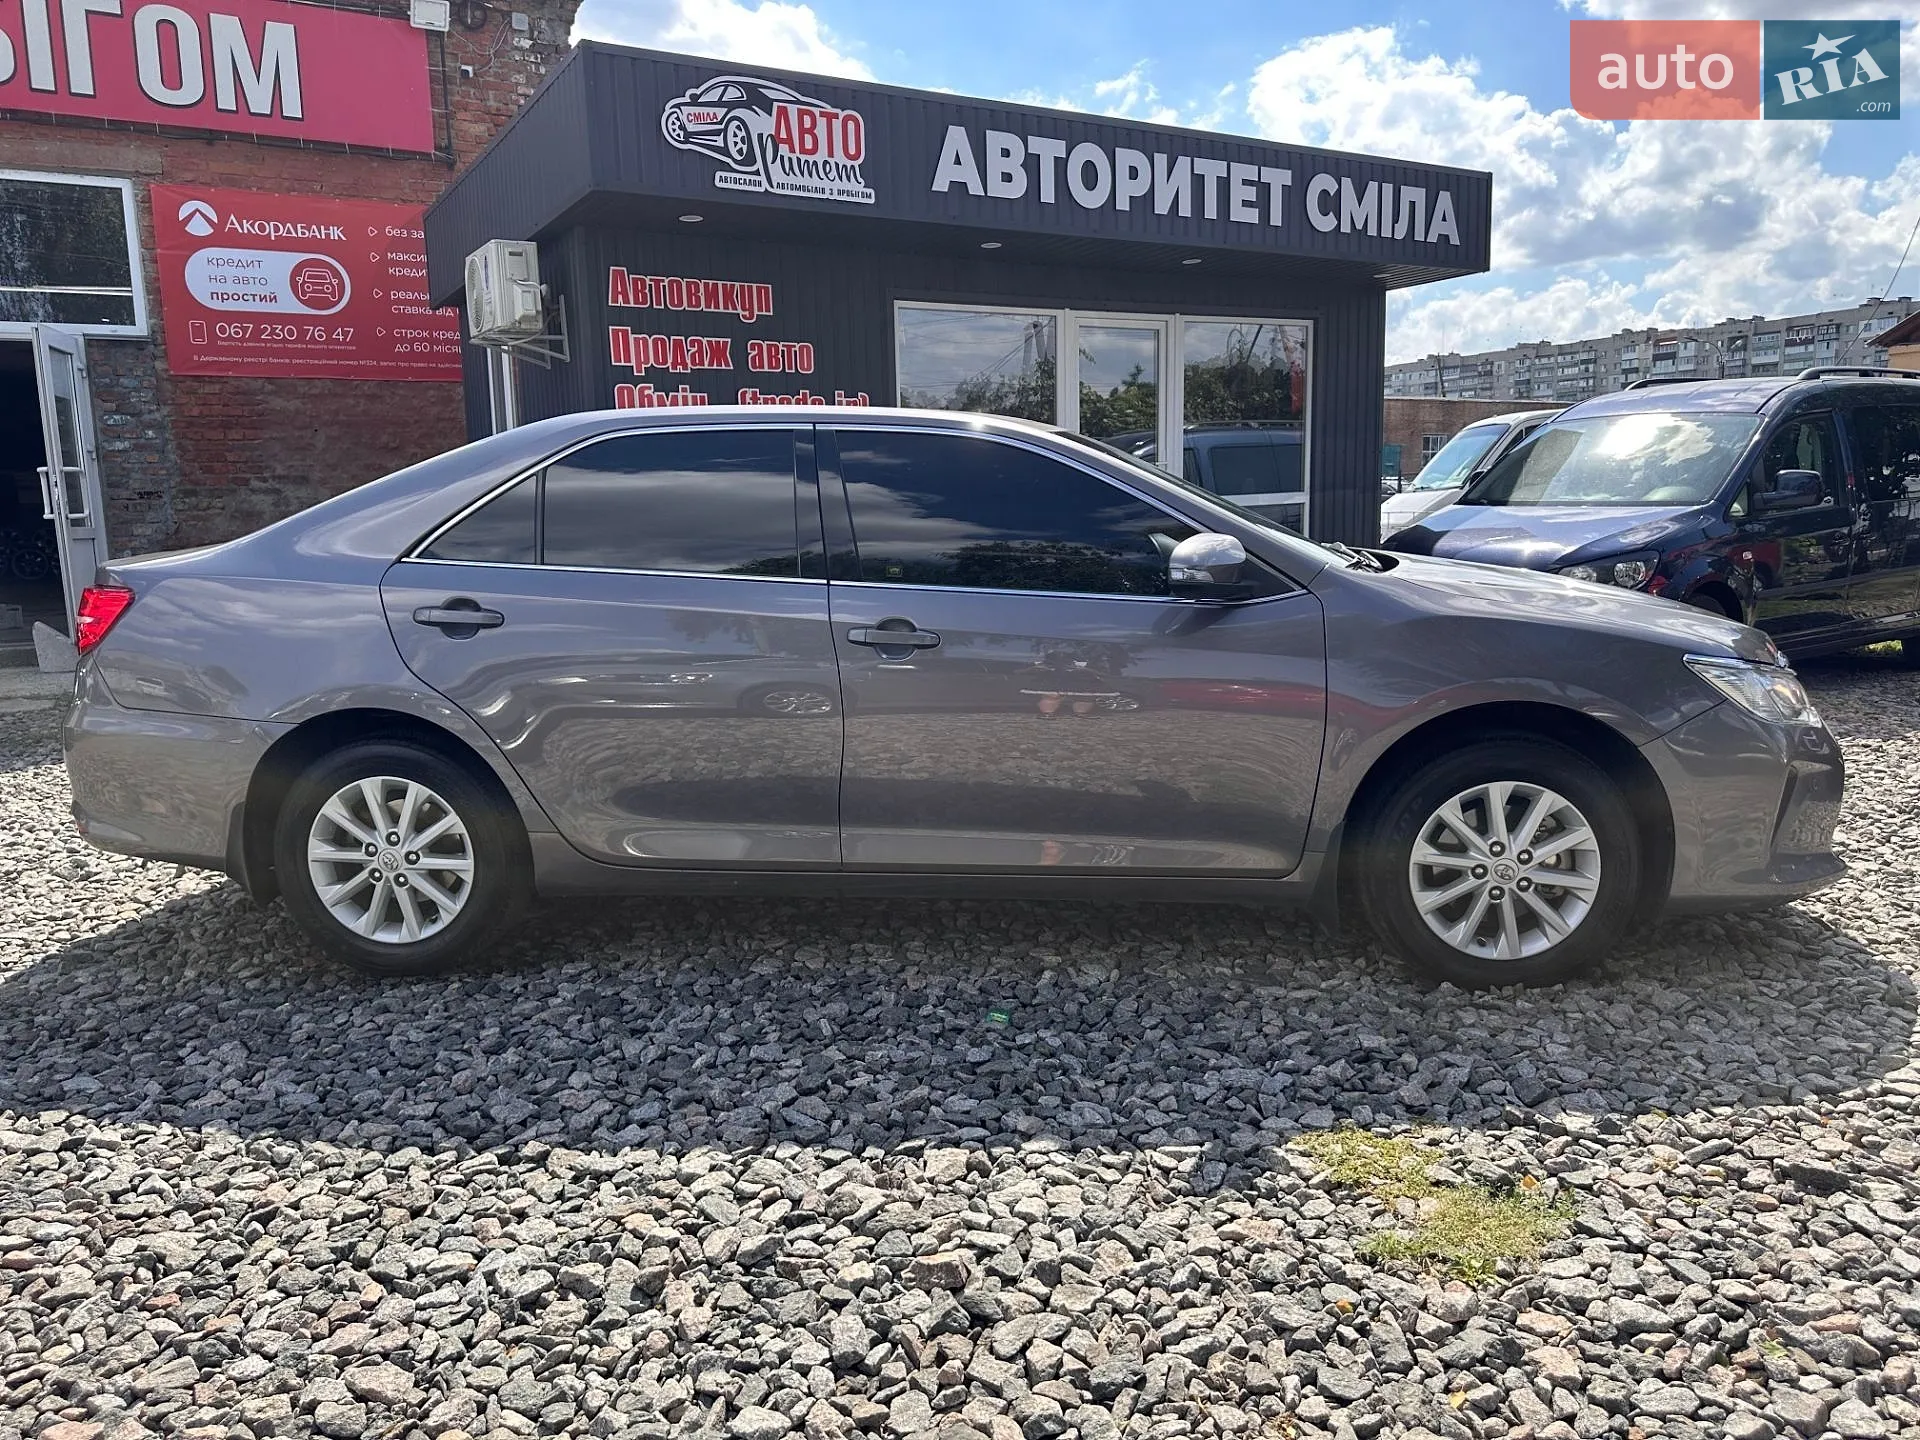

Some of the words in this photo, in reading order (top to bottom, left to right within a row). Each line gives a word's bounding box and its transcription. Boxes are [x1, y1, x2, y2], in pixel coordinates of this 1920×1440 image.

[686, 111, 719, 124] СМІЛА
[774, 105, 862, 162] АВТО
[718, 174, 763, 189] АВТОСАЛОН
[931, 125, 1293, 227] АВТОРИТЕТ
[1306, 172, 1461, 246] СМІЛА
[775, 181, 827, 196] АВТОМОБІЛІВ
[836, 188, 873, 201] ПРОБІГОМ
[385, 226, 408, 238] без
[206, 256, 264, 270] кредит
[388, 267, 428, 278] креди
[208, 274, 227, 285] на
[232, 275, 269, 287] авто
[209, 290, 278, 304] простий
[608, 266, 774, 323] Автовикуп
[391, 304, 433, 316] ставка
[216, 322, 254, 338] 067
[260, 324, 297, 340] 230
[303, 326, 327, 341] 76
[332, 327, 354, 343] 47
[393, 328, 430, 340] строк
[394, 341, 411, 353] до
[413, 342, 430, 353] 60
[608, 325, 734, 376] Продаж
[747, 339, 815, 374] авто
